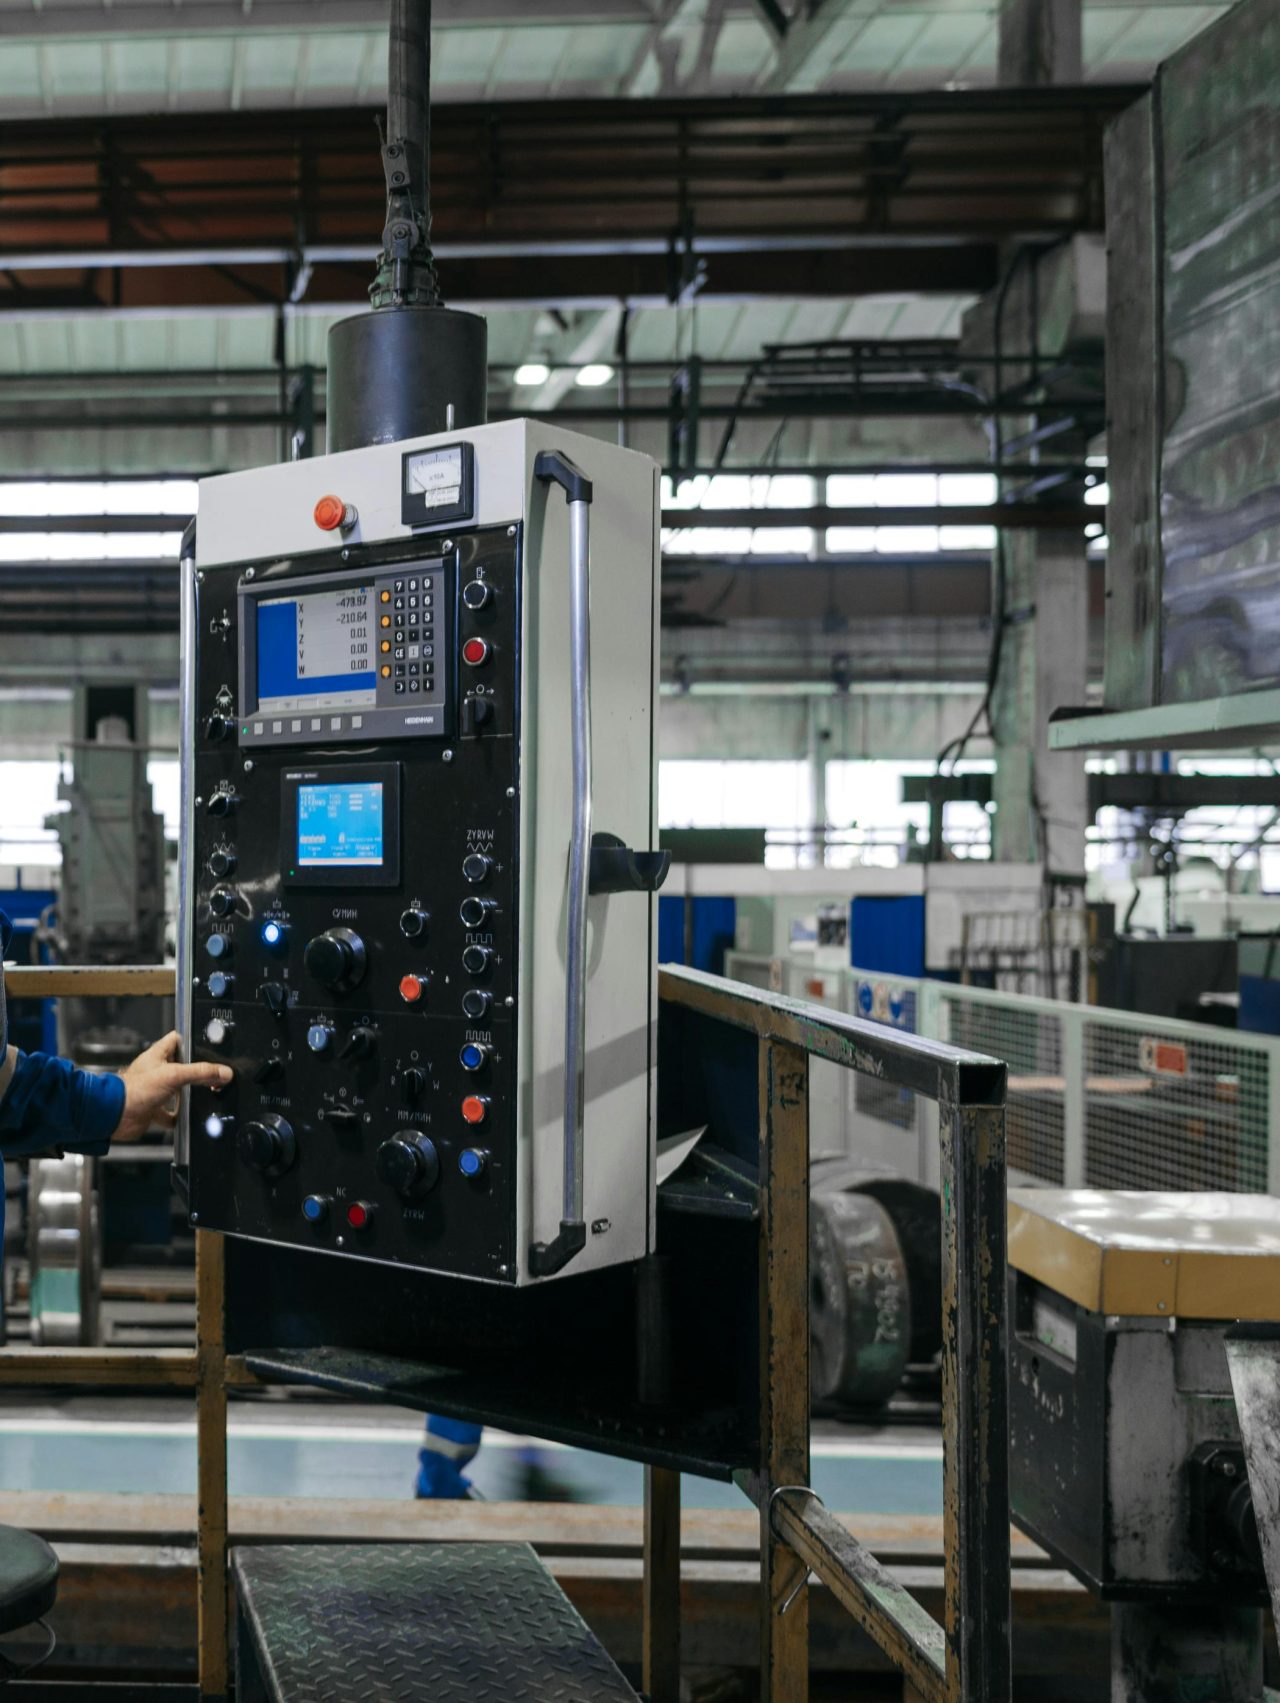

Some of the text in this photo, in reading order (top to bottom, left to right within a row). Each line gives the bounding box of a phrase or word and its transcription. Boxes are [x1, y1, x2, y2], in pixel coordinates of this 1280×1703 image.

[396, 578, 431, 591] 7 8 9
[396, 595, 431, 608] 4 5 6
[298, 603, 304, 613] X
[410, 614, 416, 624] 2
[424, 612, 431, 622] 3
[298, 628, 367, 644] Z 0.01
[350, 643, 368, 655] 0.00
[395, 648, 404, 658] CE
[298, 659, 368, 675] W 0.00
[466, 829, 494, 840] ZYRVW
[433, 1079, 440, 1090] W
[336, 1186, 347, 1198] NC
